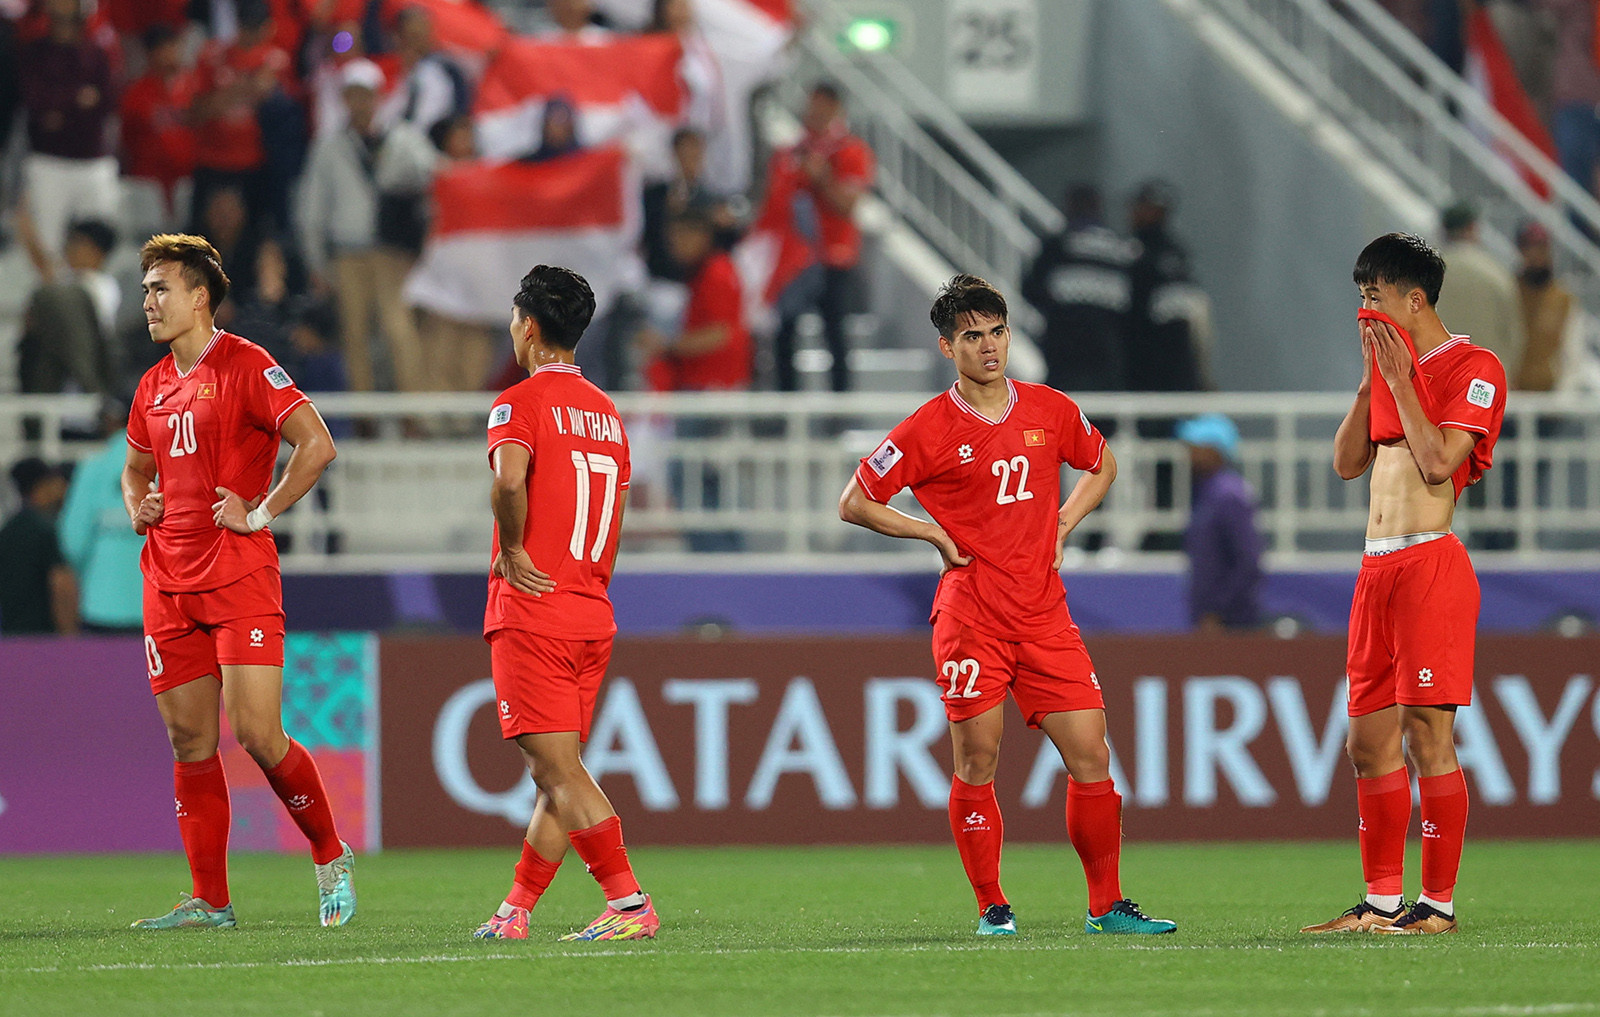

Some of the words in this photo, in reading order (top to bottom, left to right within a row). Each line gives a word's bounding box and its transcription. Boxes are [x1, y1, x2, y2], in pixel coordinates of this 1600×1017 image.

[167, 410, 198, 458] 20
[551, 406, 568, 435] V.
[991, 455, 1034, 505] 22
[569, 449, 619, 563] 17
[144, 634, 164, 680] 0
[942, 658, 982, 699] 22
